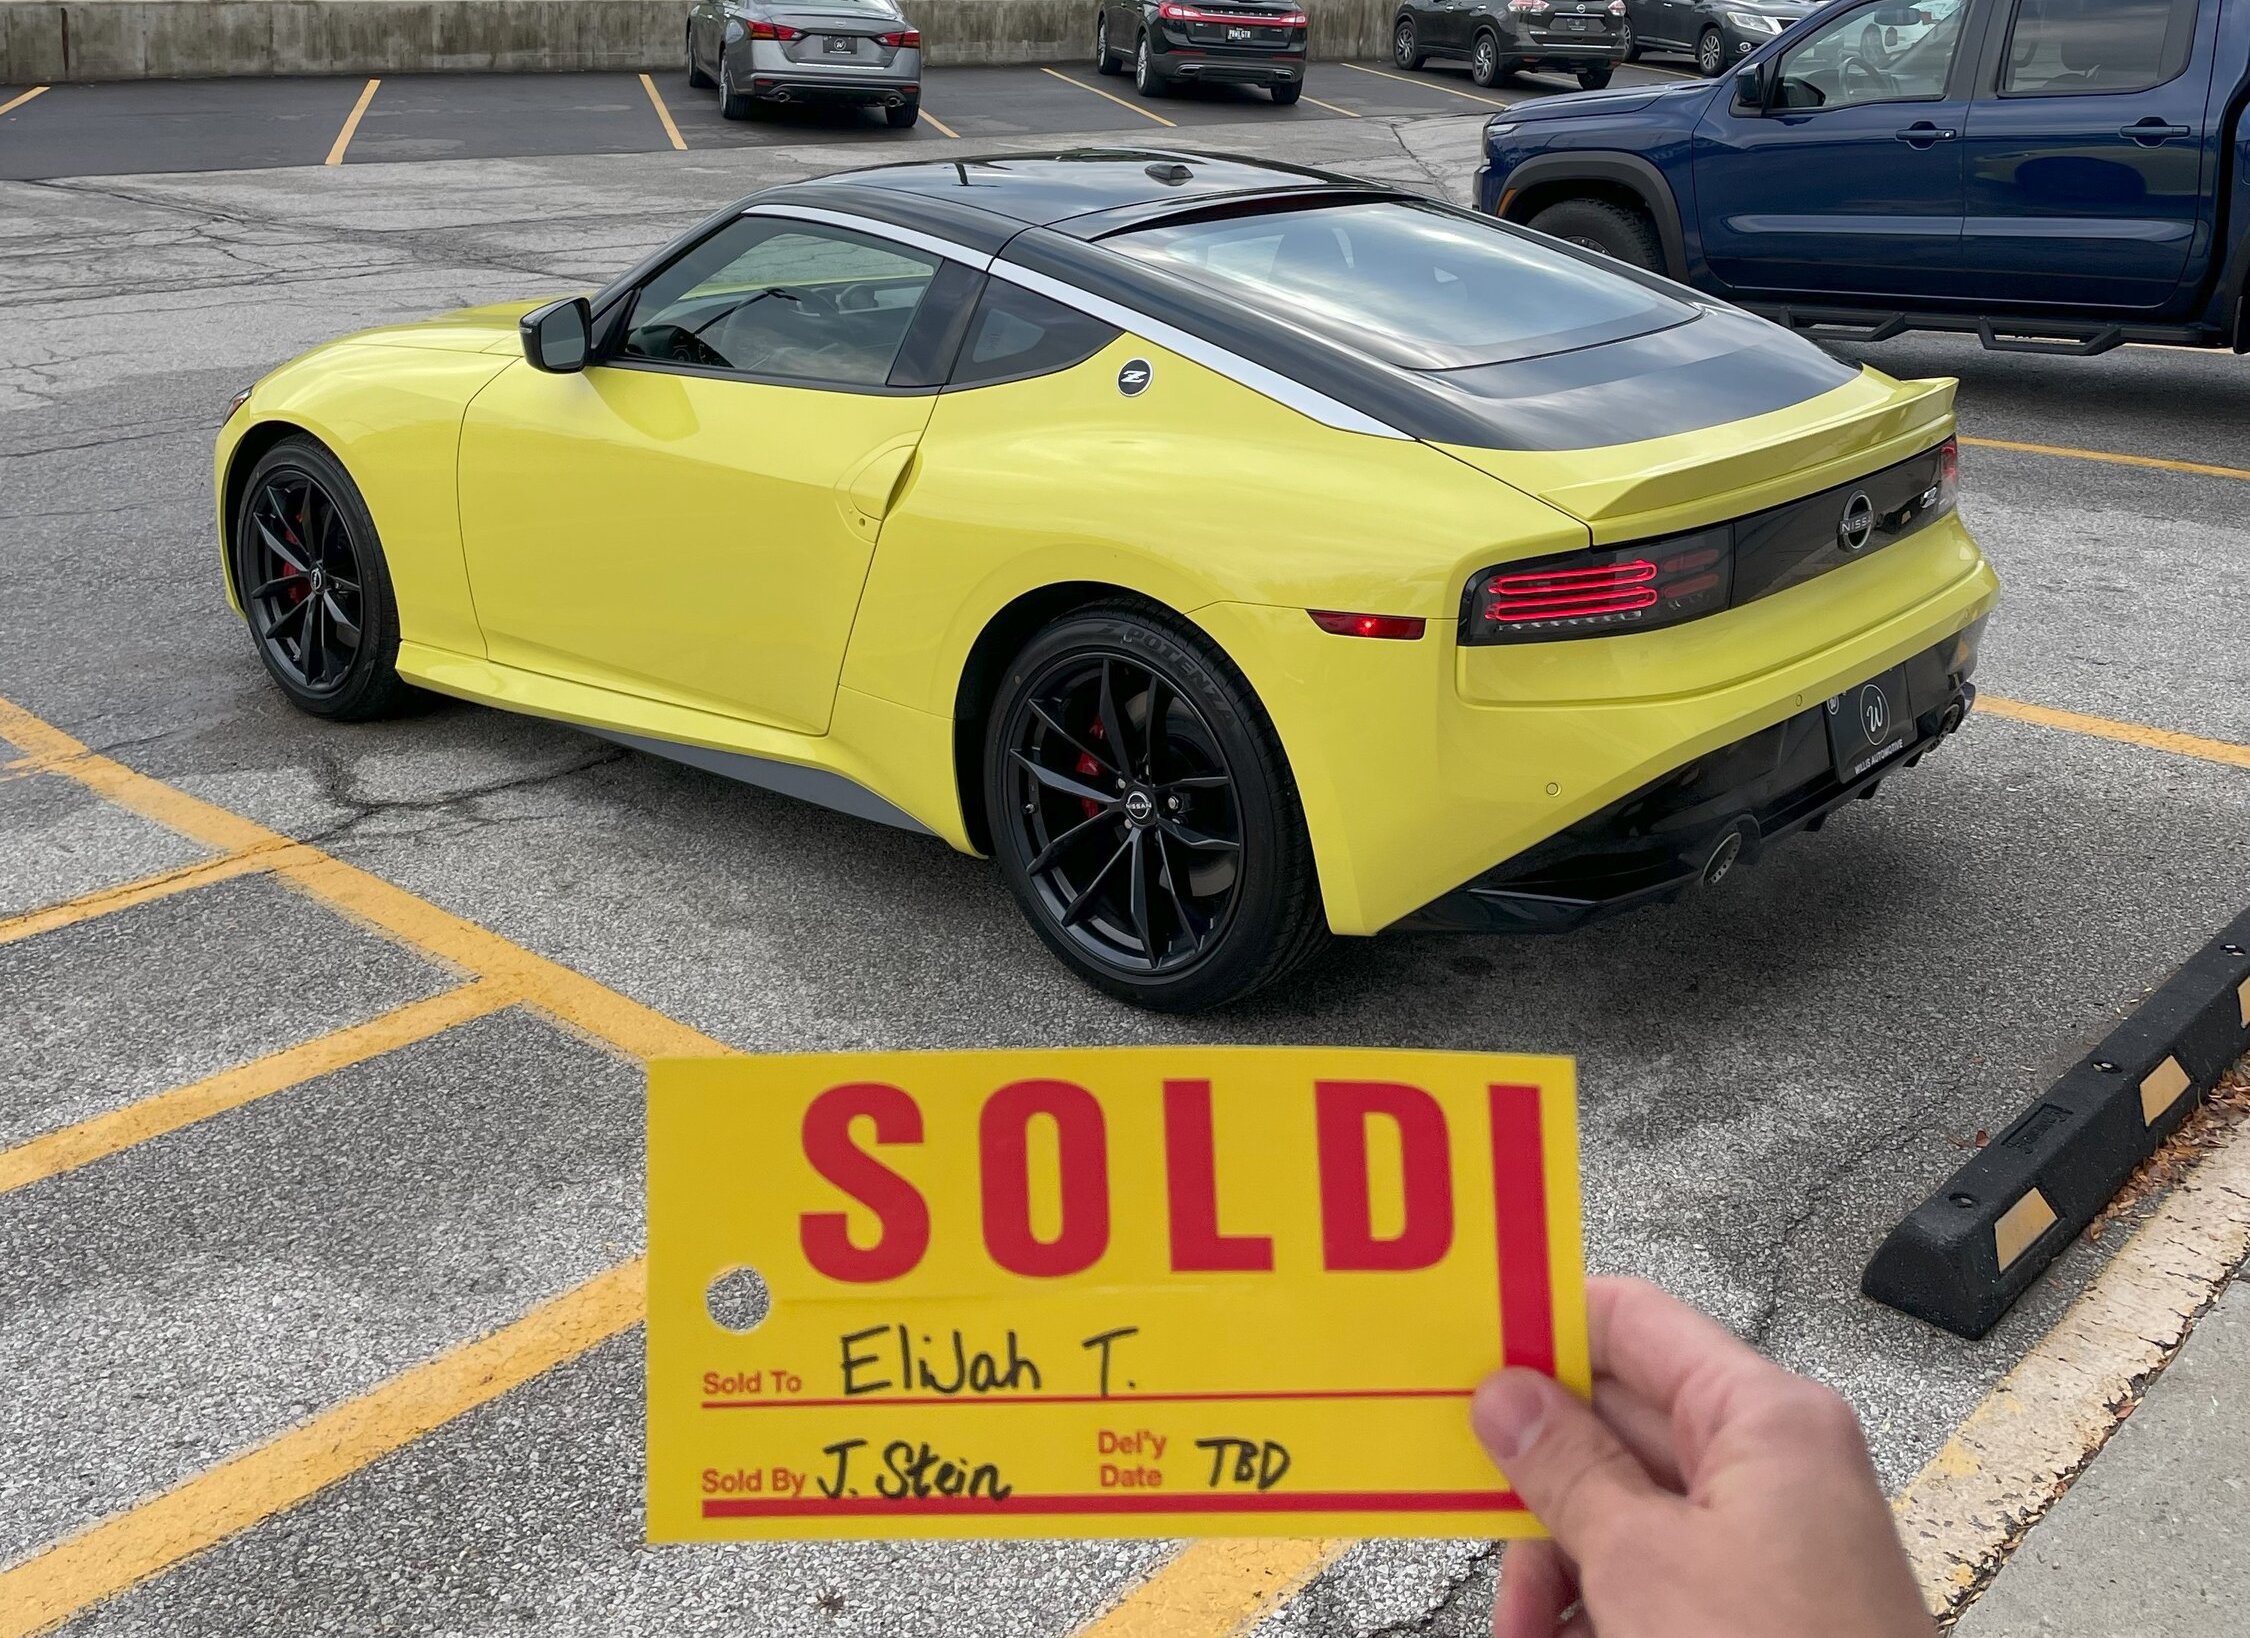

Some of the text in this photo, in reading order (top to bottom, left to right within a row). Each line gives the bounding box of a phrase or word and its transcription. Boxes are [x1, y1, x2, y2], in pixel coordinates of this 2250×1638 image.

[1081, 1326, 1139, 1398] T.
[703, 1370, 802, 1395] Sold To
[1098, 1430, 1167, 1460] Del'y
[816, 1438, 1013, 1502] J. Stein
[1100, 1464, 1163, 1489] Date
[1194, 1437, 1291, 1492] TBD
[702, 1466, 807, 1498] Sold By
